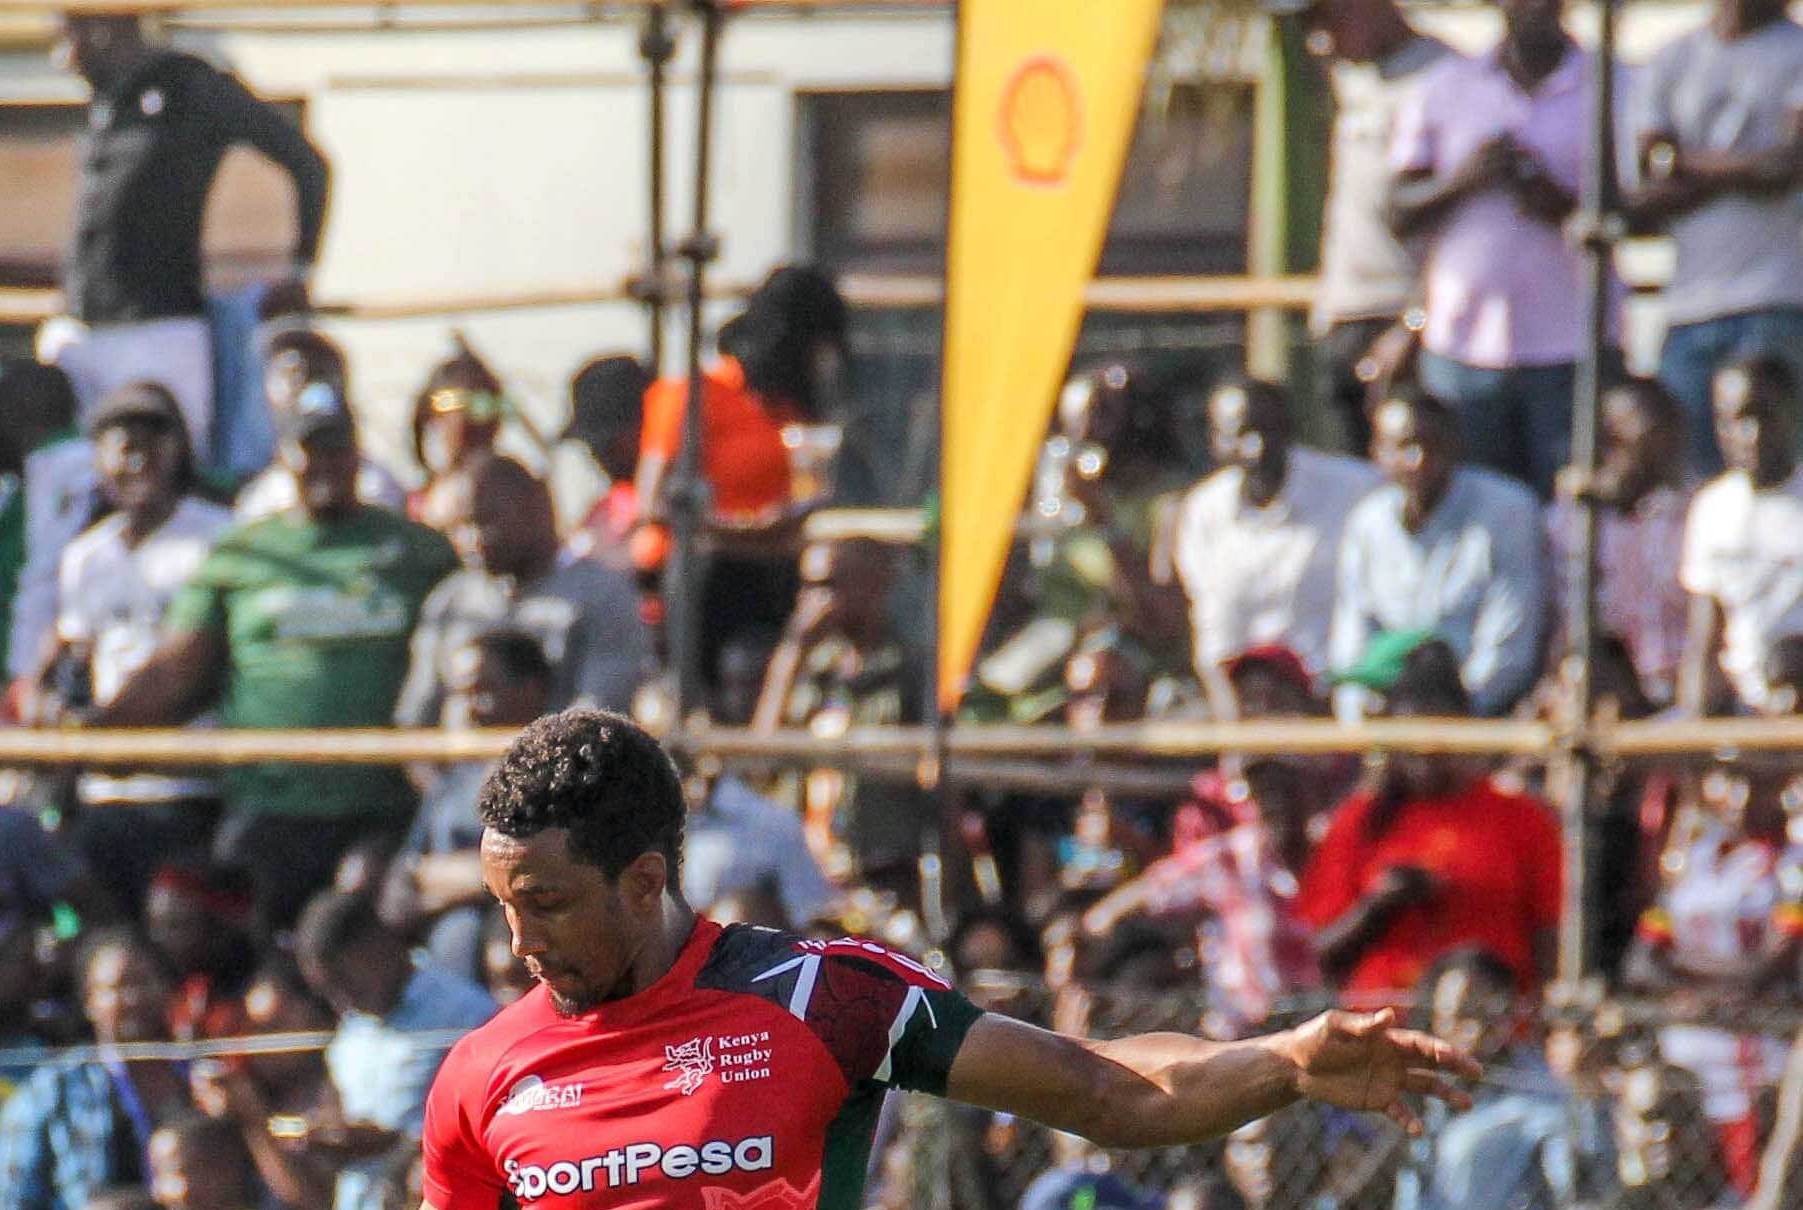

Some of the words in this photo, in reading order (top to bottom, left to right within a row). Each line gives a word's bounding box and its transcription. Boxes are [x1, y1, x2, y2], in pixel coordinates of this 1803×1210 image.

[719, 1031, 769, 1049] Kenya
[720, 1048, 773, 1067] Rugby
[721, 1067, 770, 1083] Union
[503, 1135, 774, 1200] SportPesa
